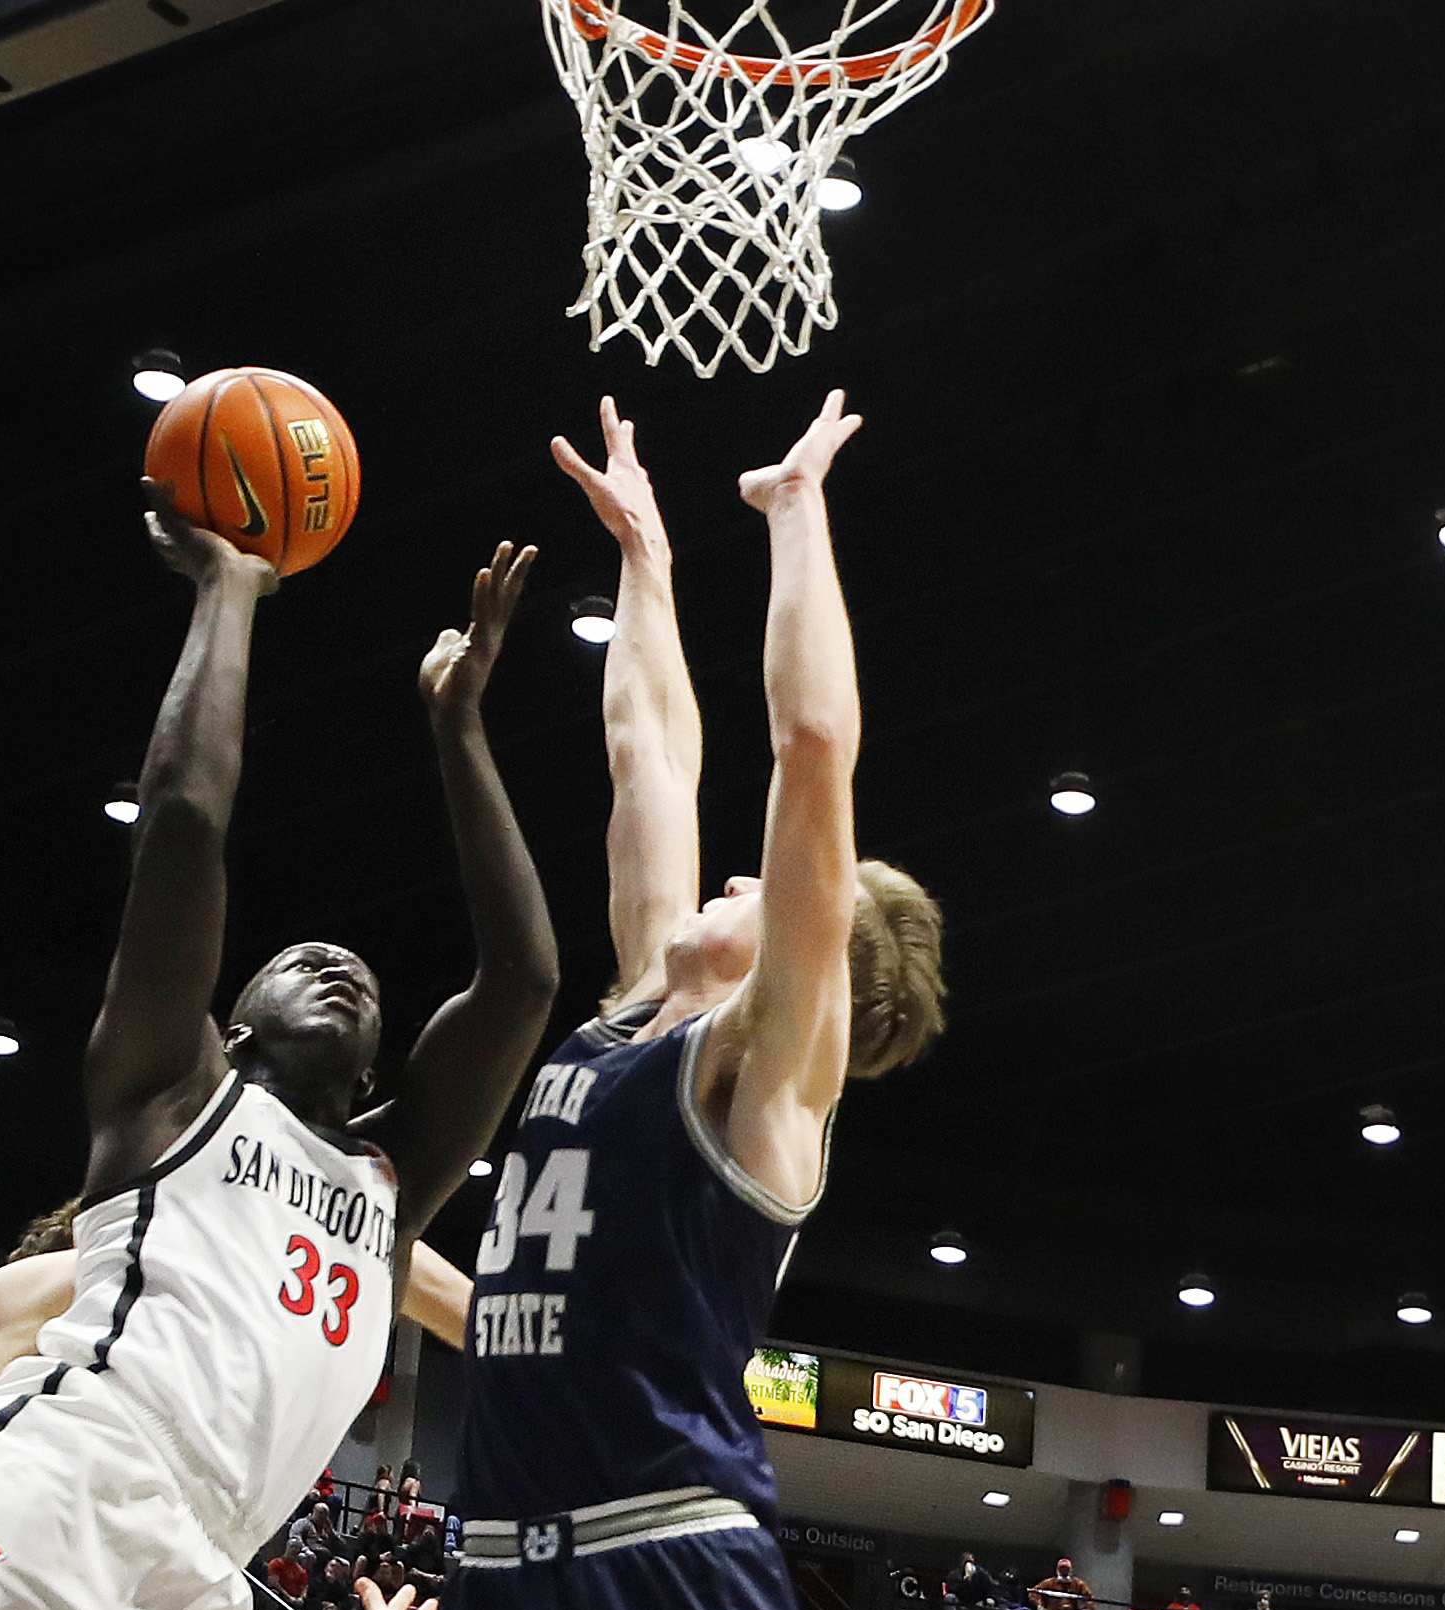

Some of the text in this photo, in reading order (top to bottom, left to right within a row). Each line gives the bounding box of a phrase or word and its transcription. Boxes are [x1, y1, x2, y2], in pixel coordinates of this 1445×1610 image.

[221, 1134, 283, 1194] SAN
[288, 1168, 370, 1246] DIEGO
[474, 1147, 596, 1277] 34
[278, 1233, 360, 1347] 33
[474, 1292, 567, 1360] STATE
[877, 1375, 981, 1421] FOX 5
[892, 1413, 935, 1443] San
[938, 1421, 1005, 1455] Diego
[1278, 1426, 1361, 1467] VIEJAS
[1283, 1460, 1318, 1471] CASINO
[1324, 1464, 1360, 1475] RESORT
[804, 1526, 876, 1553] Outside
[1214, 1575, 1313, 1599] Restrooms
[1319, 1583, 1436, 1609] Concessions
